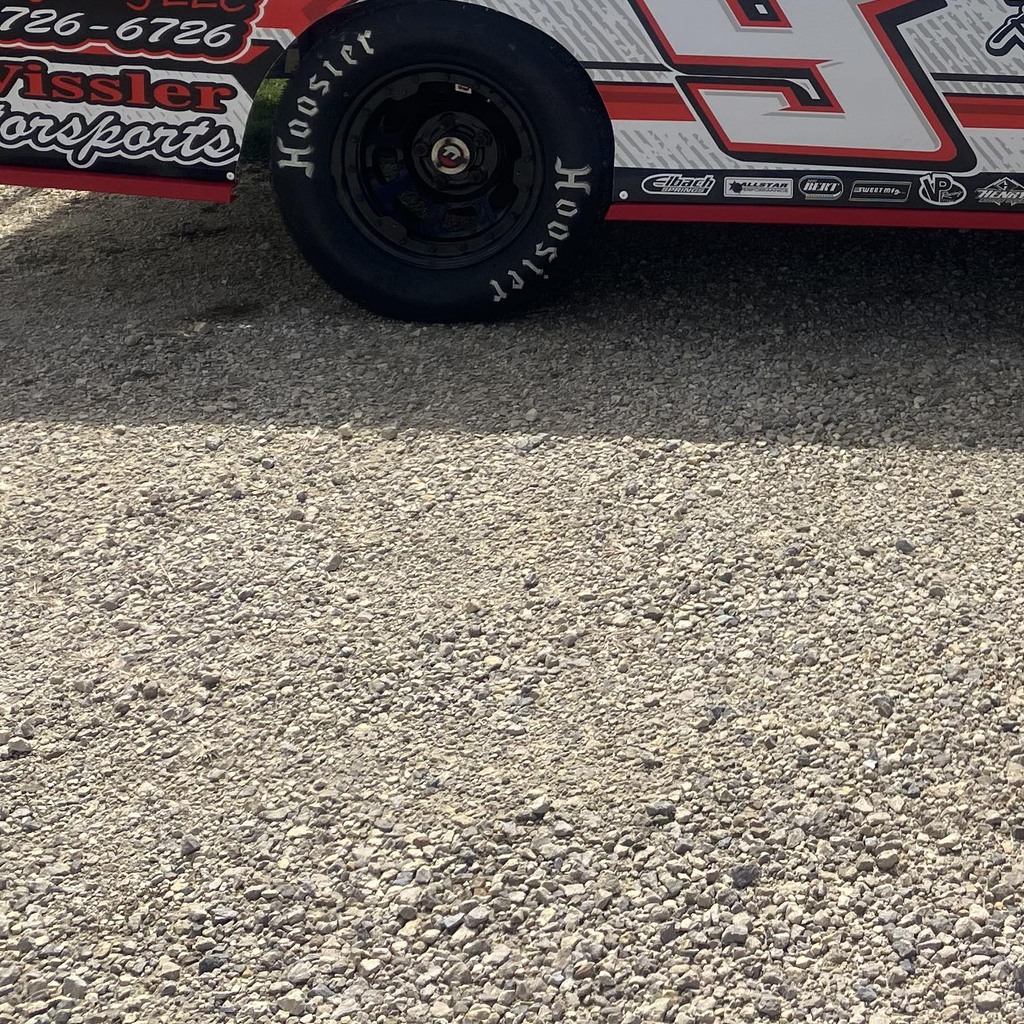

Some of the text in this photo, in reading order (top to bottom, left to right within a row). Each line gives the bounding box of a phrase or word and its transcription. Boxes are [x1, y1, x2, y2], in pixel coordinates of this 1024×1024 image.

[0, 103, 236, 161] orsports
[276, 29, 375, 178] Hoosier
[488, 156, 593, 303] Hoosier
